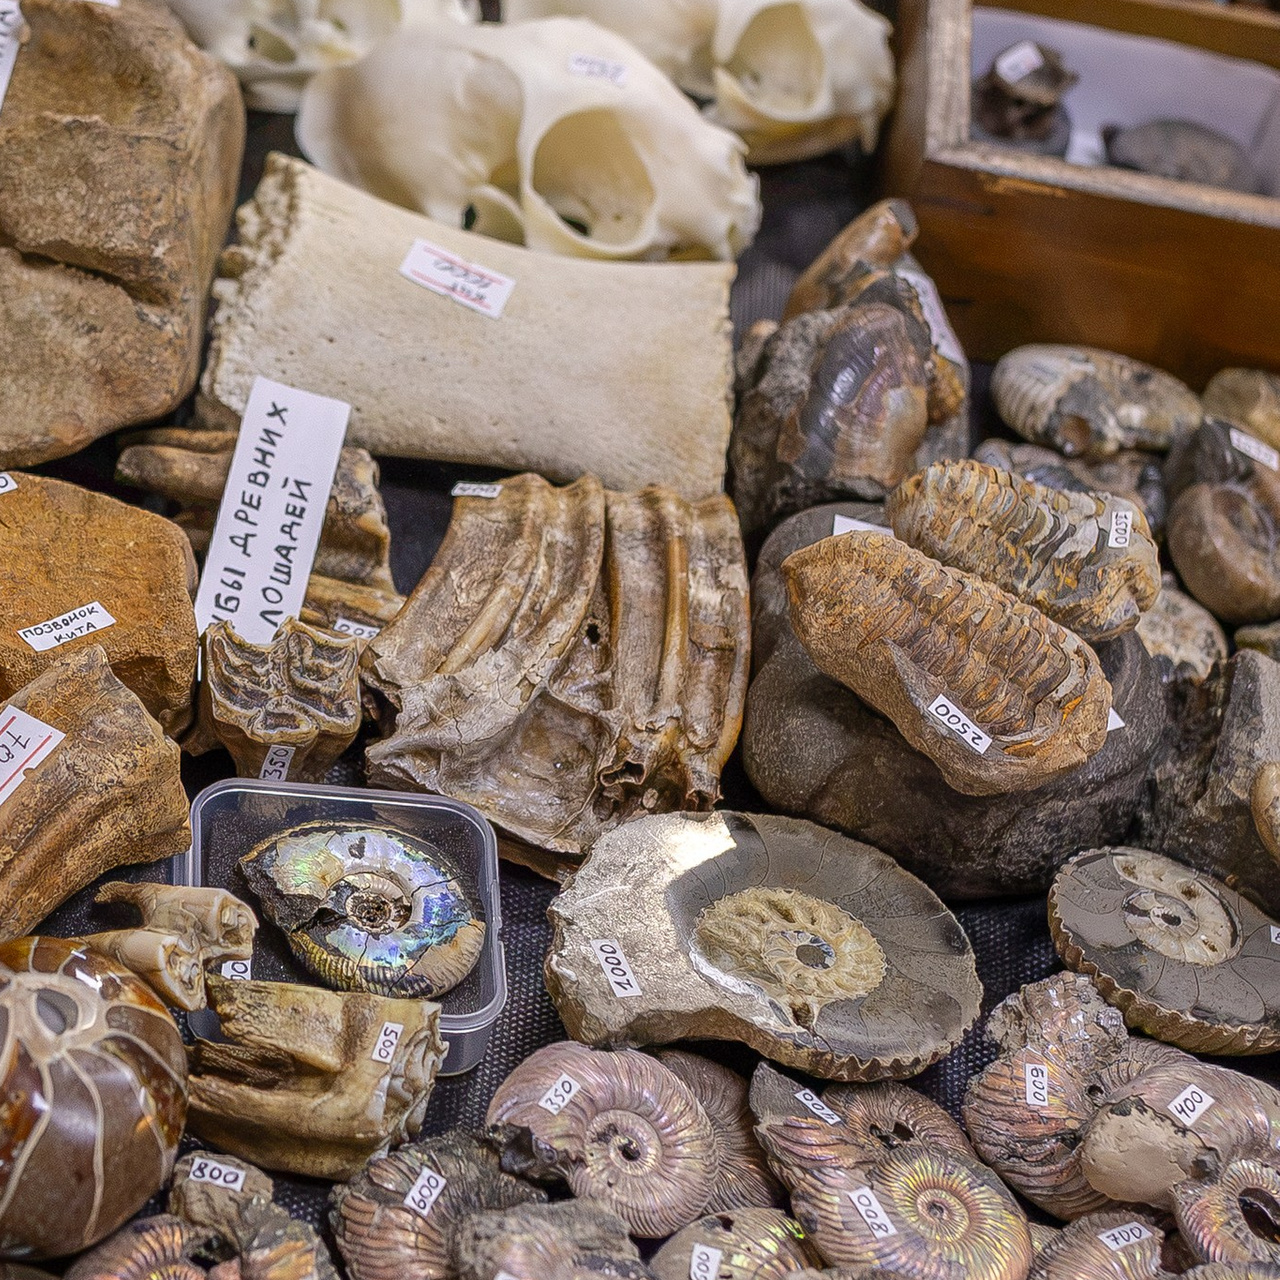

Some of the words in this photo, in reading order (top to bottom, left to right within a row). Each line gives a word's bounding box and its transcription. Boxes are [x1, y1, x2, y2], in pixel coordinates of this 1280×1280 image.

[231, 401, 290, 558] ДРЕВНИХ
[260, 478, 313, 628] ЛОШАДЕЙ
[21, 605, 100, 639] ПОЗВОНОК
[53, 621, 98, 644] КИТА
[935, 703, 983, 747] 2500
[263, 748, 289, 780] 350
[378, 1026, 399, 1059] 500
[544, 1080, 573, 1112] 350
[1030, 1067, 1046, 1102] 600
[1174, 1090, 1204, 1119] 400
[191, 1161, 240, 1184] 800
[411, 1175, 439, 1210] 600
[857, 1194, 889, 1233] 800
[1106, 1226, 1143, 1246] 700
